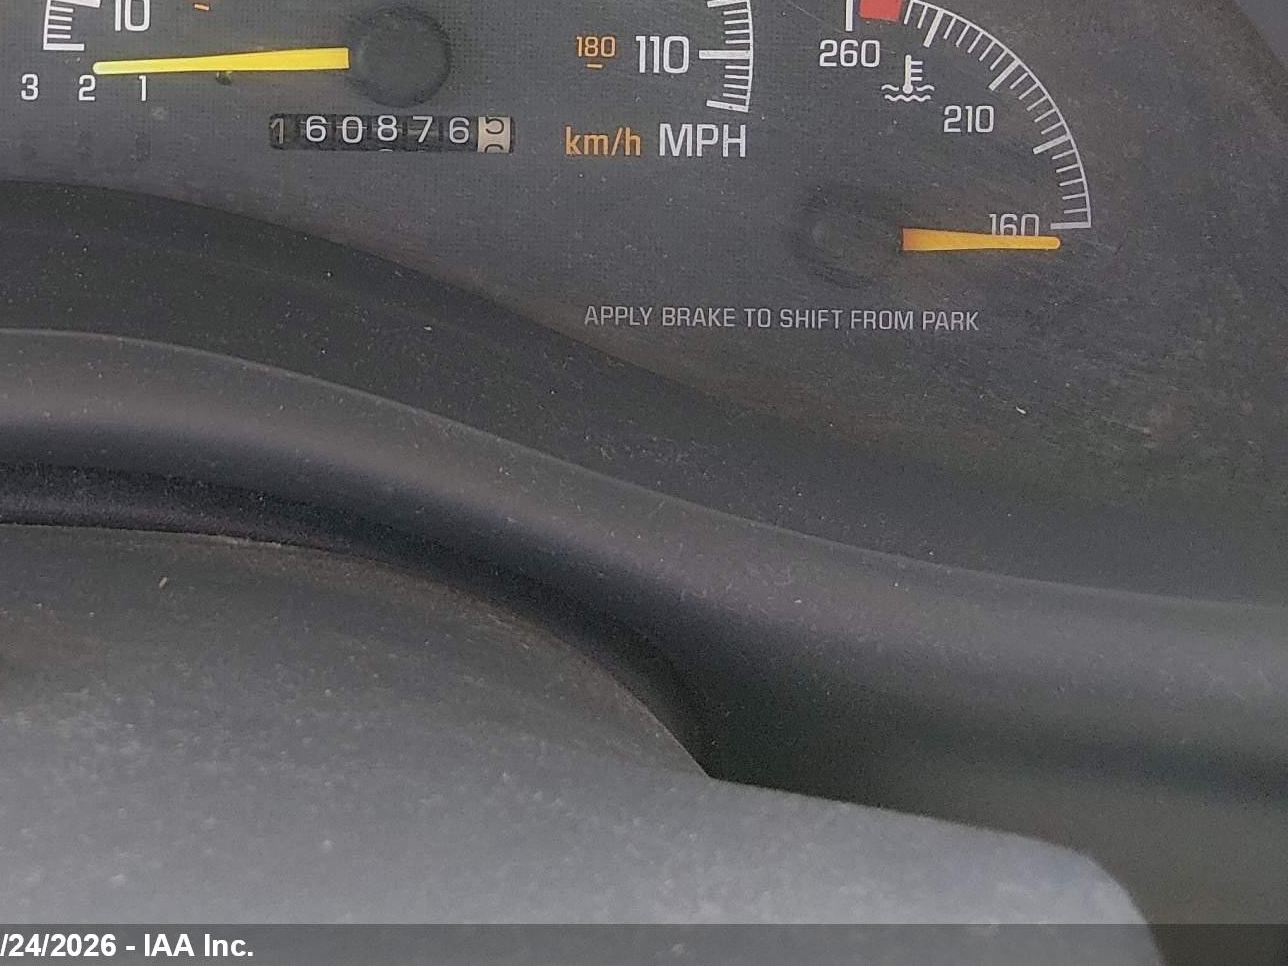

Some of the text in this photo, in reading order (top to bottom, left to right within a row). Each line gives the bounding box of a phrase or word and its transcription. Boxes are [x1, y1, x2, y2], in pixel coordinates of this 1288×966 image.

[576, 36, 616, 58] 180
[635, 35, 690, 74] 110
[819, 39, 880, 68] 260
[21, 73, 39, 101] 3
[78, 74, 96, 101] 2
[135, 74, 147, 102] 1
[943, 105, 995, 133] 210
[565, 126, 641, 156] km/h
[659, 123, 746, 158] MPH
[988, 213, 1040, 237] 160
[584, 305, 979, 331] APPLY BRAKE TO SHIFT FROM PARK
